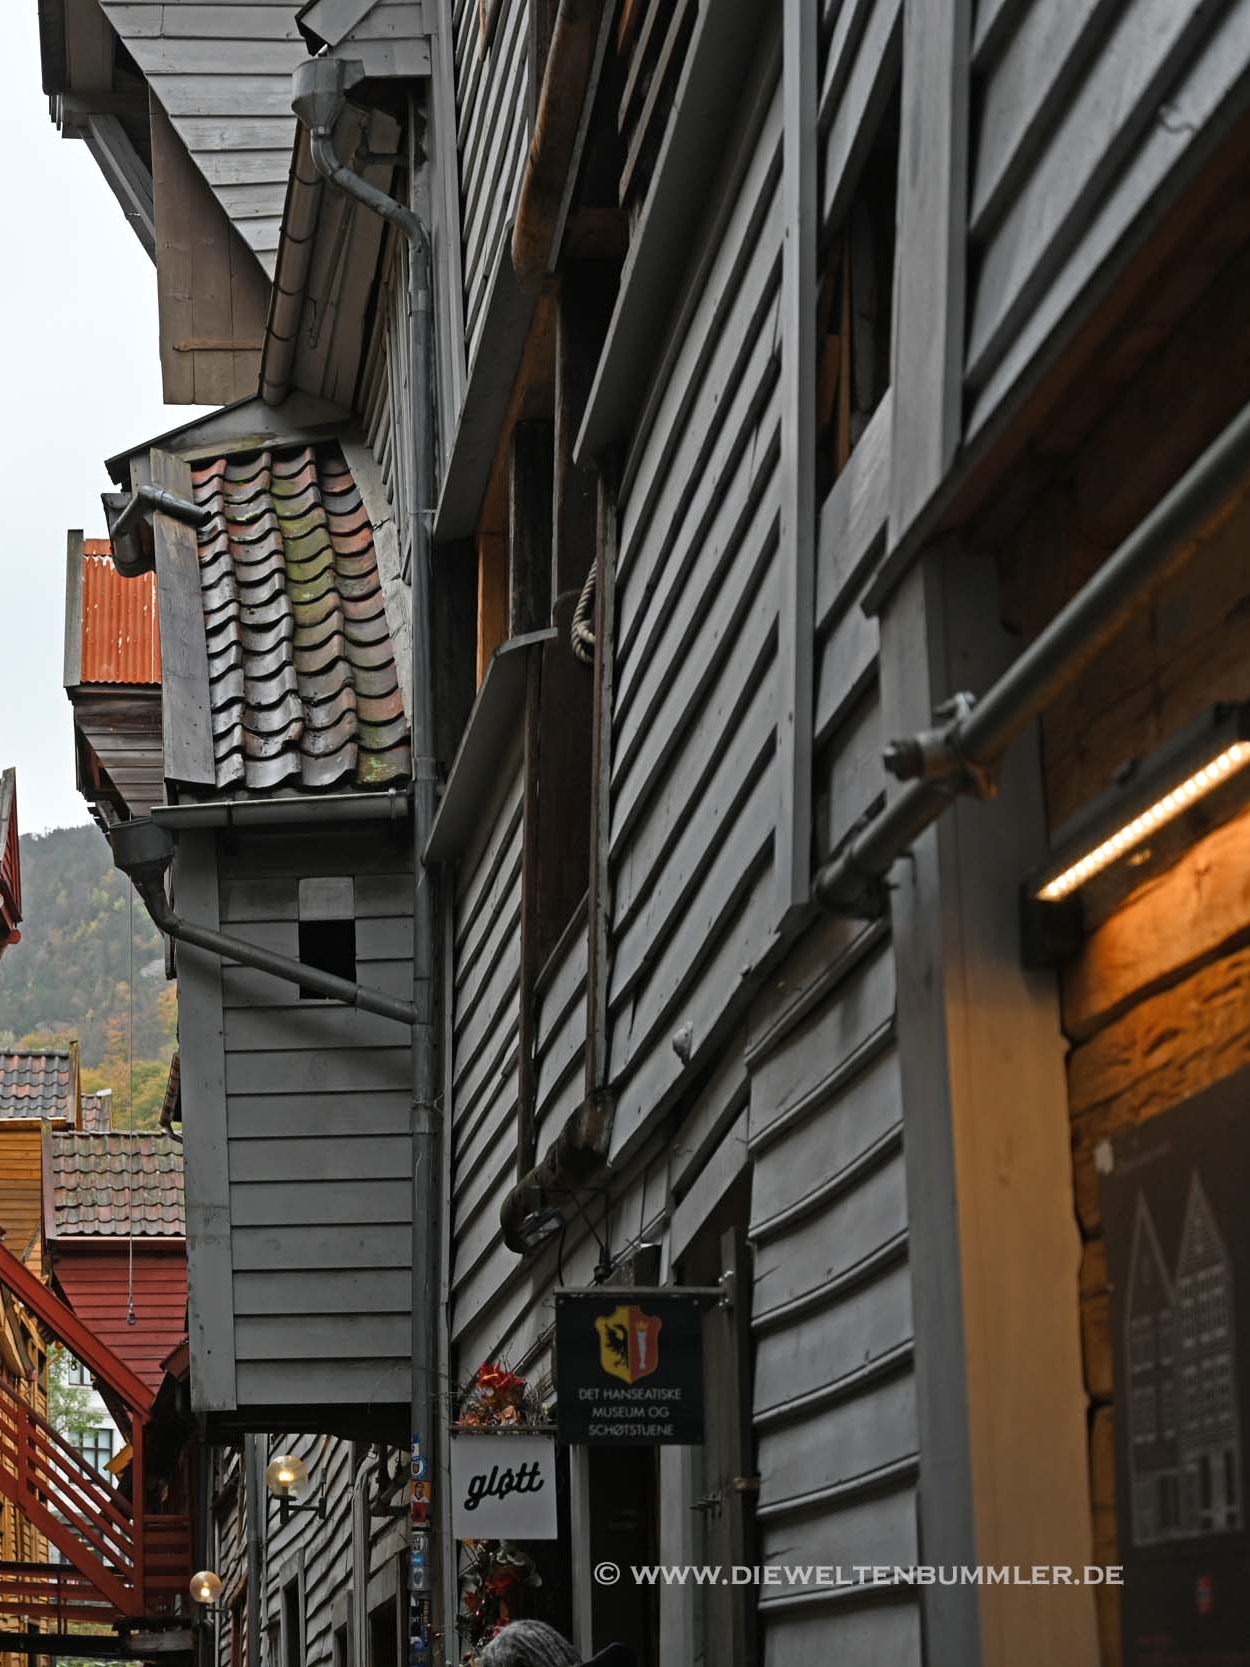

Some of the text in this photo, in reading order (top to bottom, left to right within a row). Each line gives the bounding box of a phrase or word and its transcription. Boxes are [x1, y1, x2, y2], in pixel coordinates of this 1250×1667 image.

[578, 1388, 682, 1400] DET HANSEATISKE
[592, 1407, 670, 1418] MUSEUM OG
[588, 1424, 674, 1436] SCHØTSTUENE
[463, 1461, 544, 1511] gløtt
